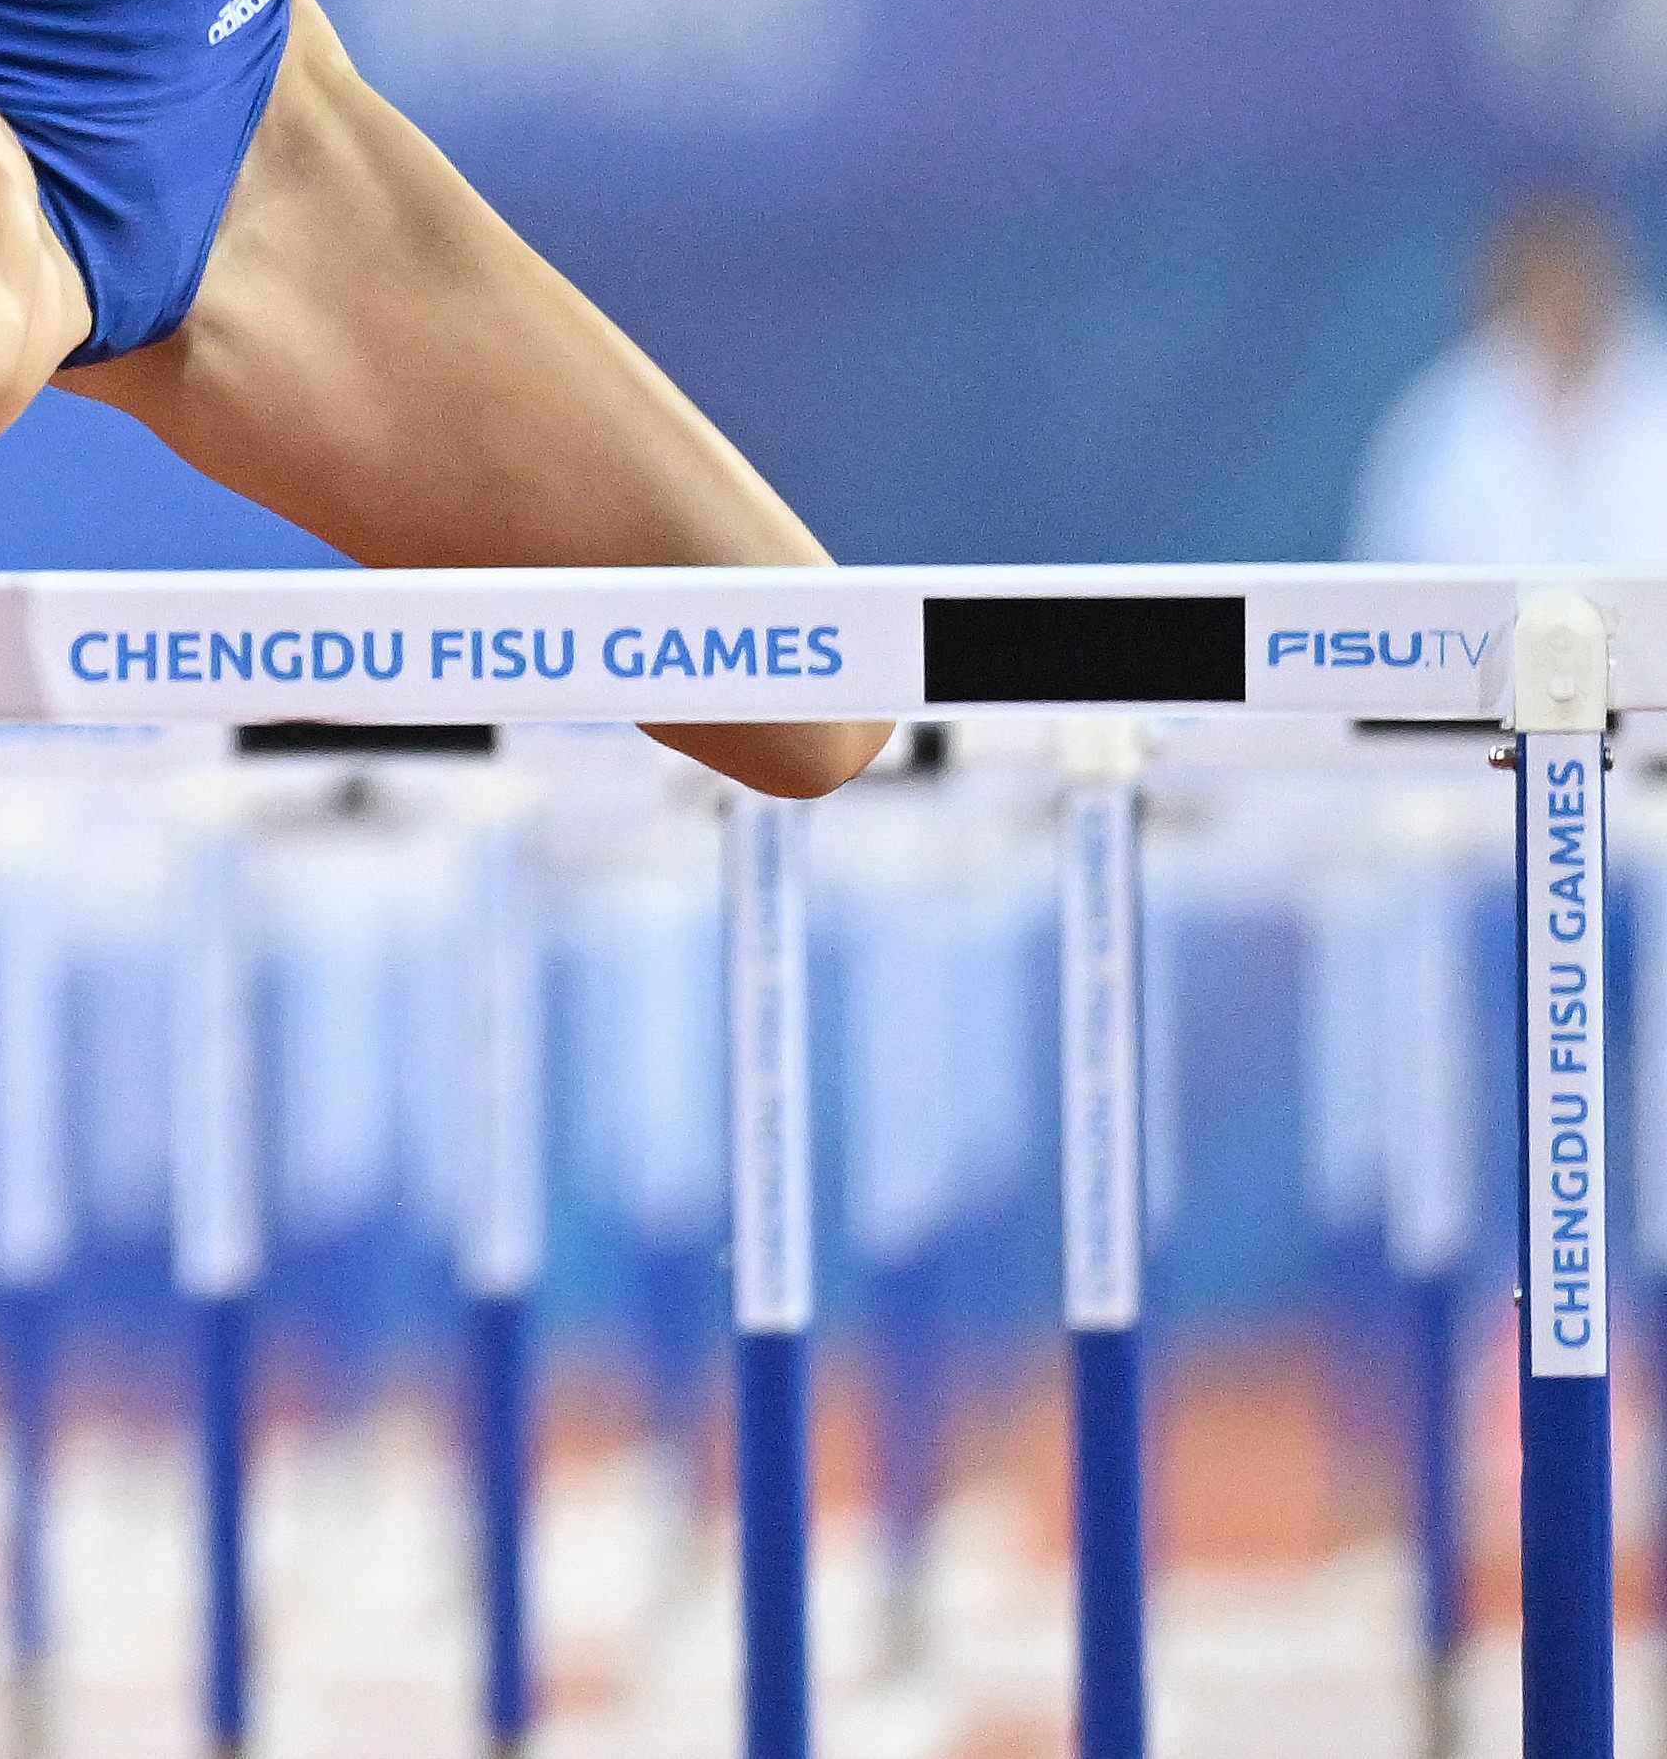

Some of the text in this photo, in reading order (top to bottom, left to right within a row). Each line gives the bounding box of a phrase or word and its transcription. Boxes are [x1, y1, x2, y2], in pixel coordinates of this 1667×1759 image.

[69, 625, 844, 684] CHENGDU FISU GAMES
[1268, 629, 1490, 669] FISU.TV
[1546, 759, 1593, 1350] CHENGDU FISU GAMES
